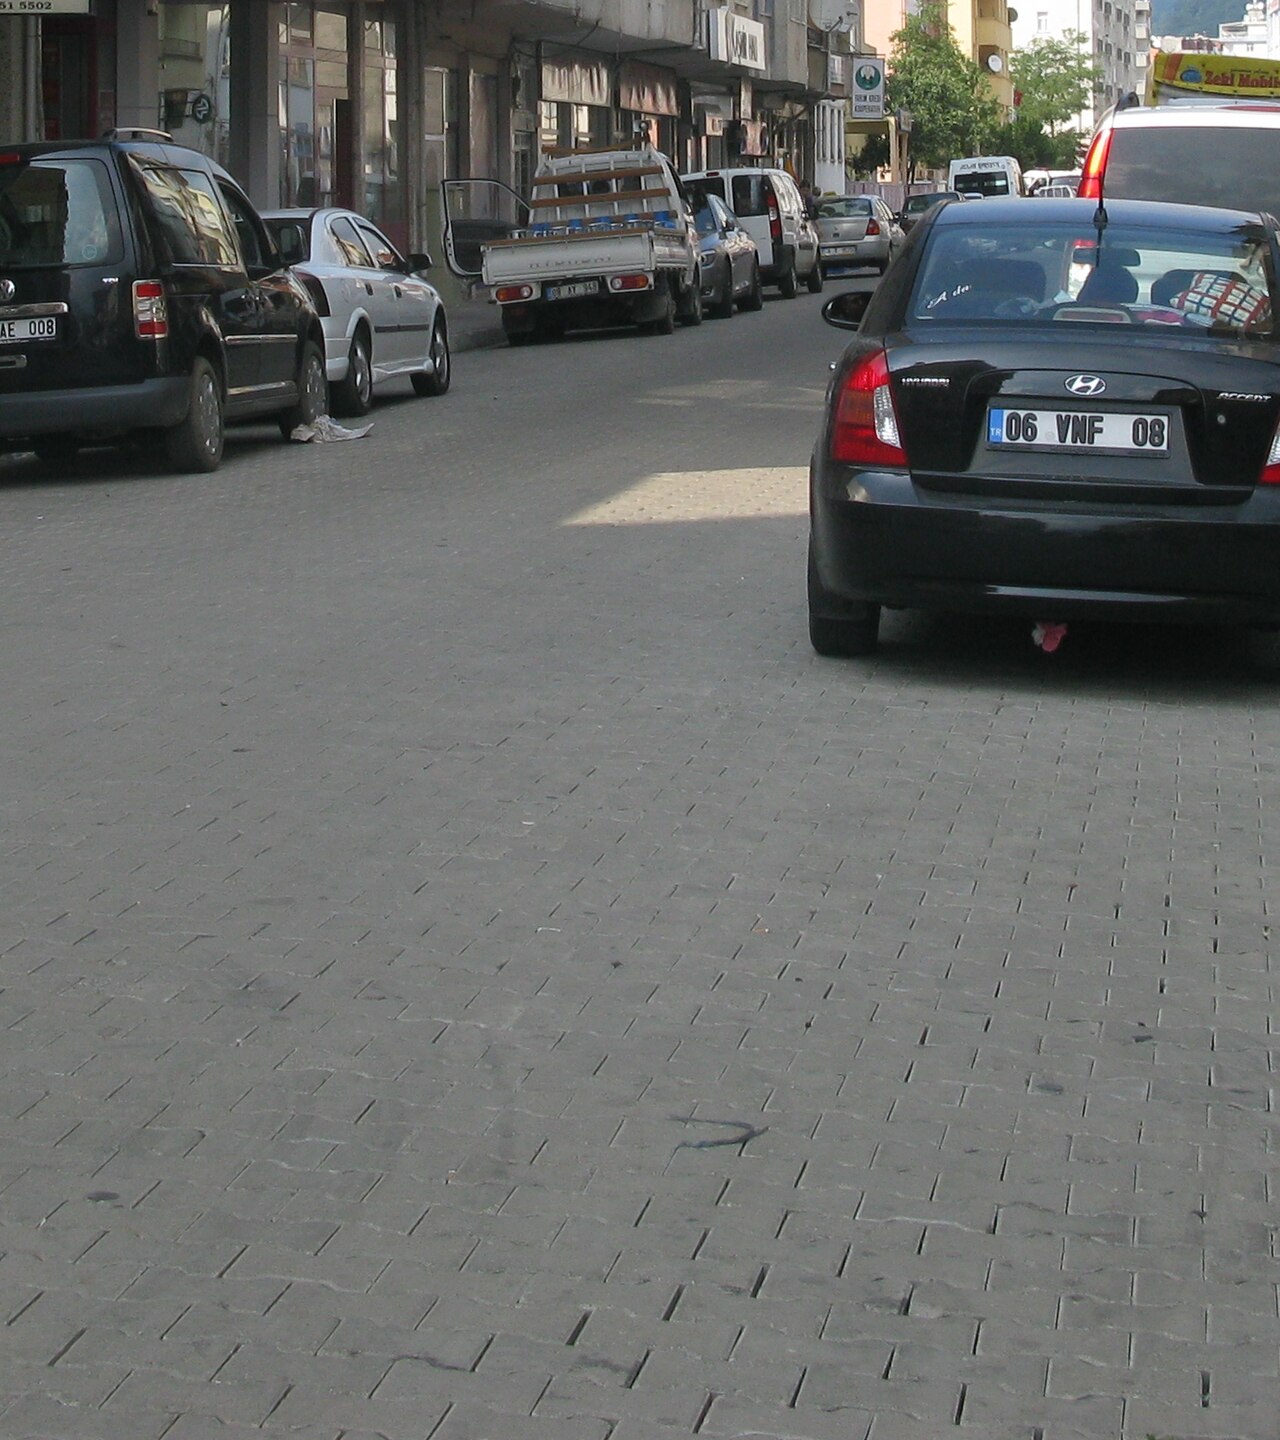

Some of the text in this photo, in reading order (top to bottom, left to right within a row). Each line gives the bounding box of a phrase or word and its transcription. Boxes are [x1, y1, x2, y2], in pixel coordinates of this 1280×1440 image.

[19, 1, 52, 10] 5502
[0, 321, 17, 339] AE
[28, 317, 55, 336] 008
[901, 377, 951, 388] HYUNDAI
[1216, 391, 1273, 402] ACCENT
[990, 411, 1166, 448] TR 06 VNF 08
